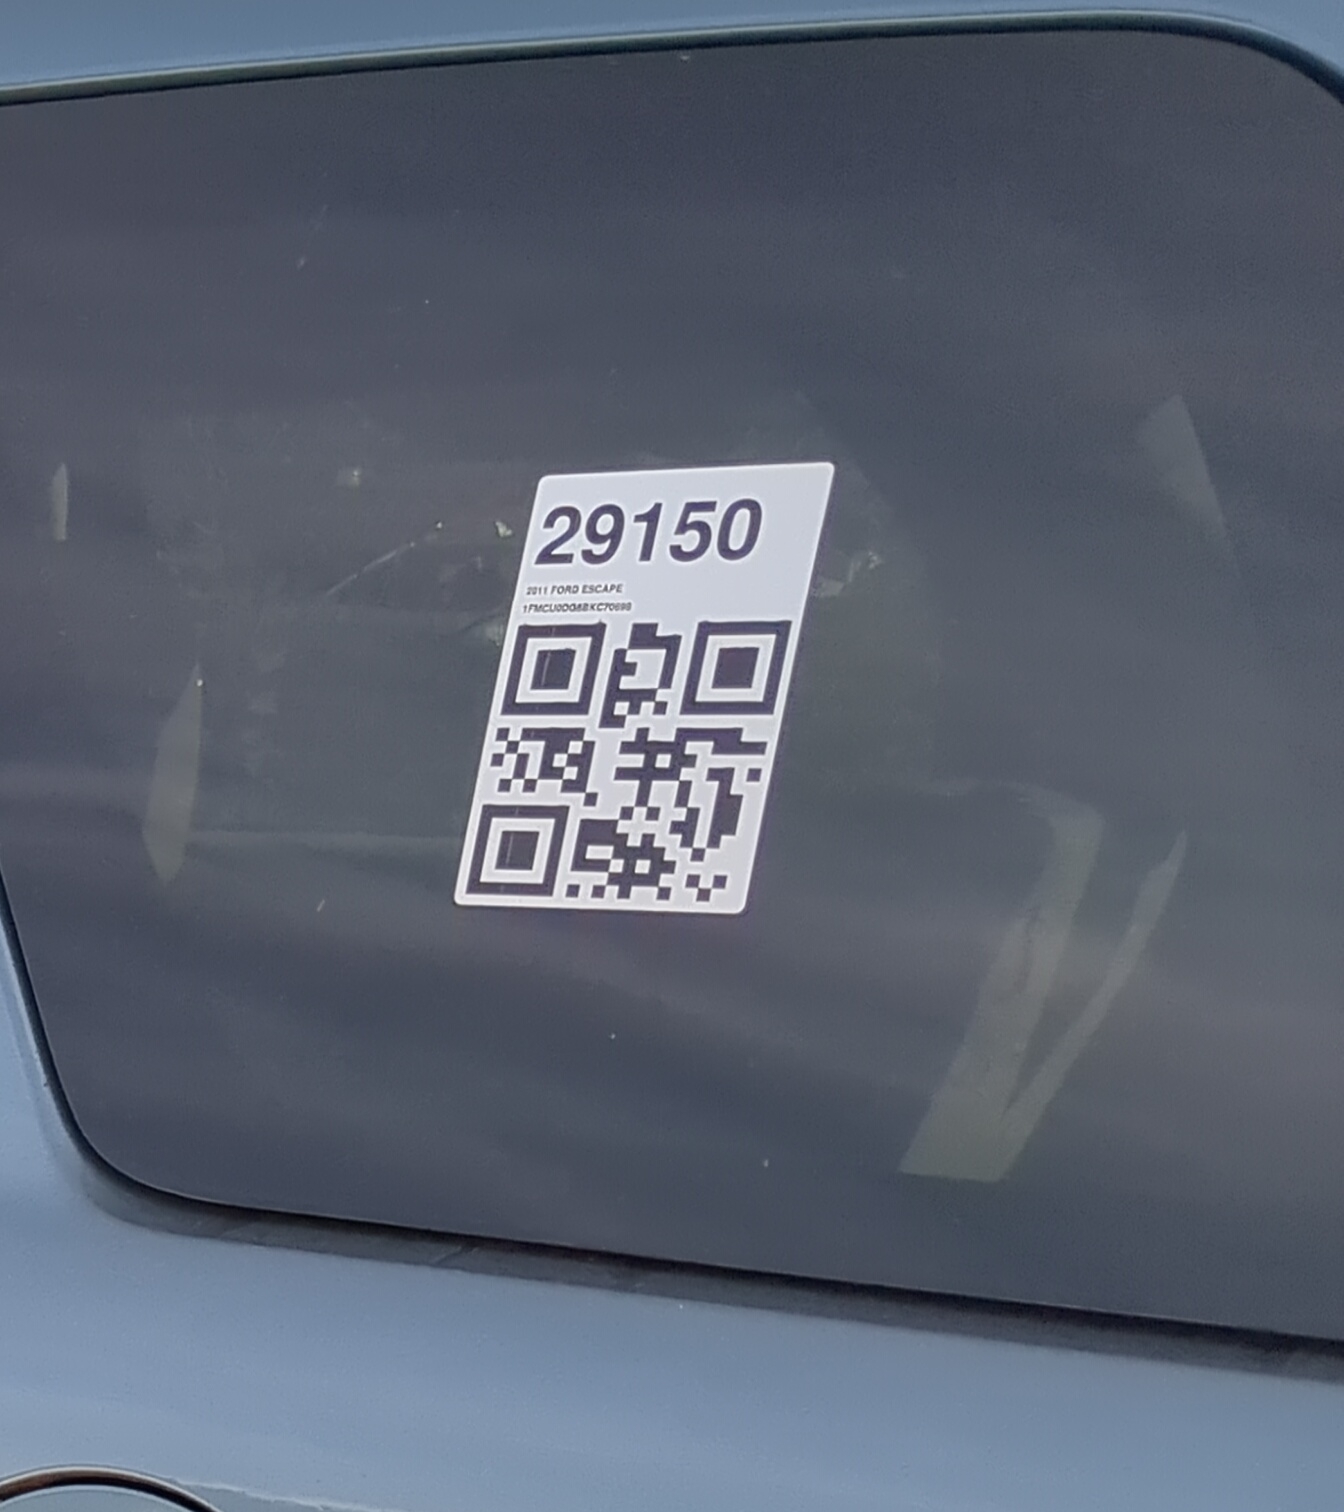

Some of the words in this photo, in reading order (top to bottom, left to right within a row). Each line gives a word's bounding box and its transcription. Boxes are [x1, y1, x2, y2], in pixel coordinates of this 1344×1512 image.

[534, 498, 763, 566] 29150
[526, 585, 548, 596] 2011
[550, 584, 579, 595] FORD
[581, 583, 624, 594] ESCAPE
